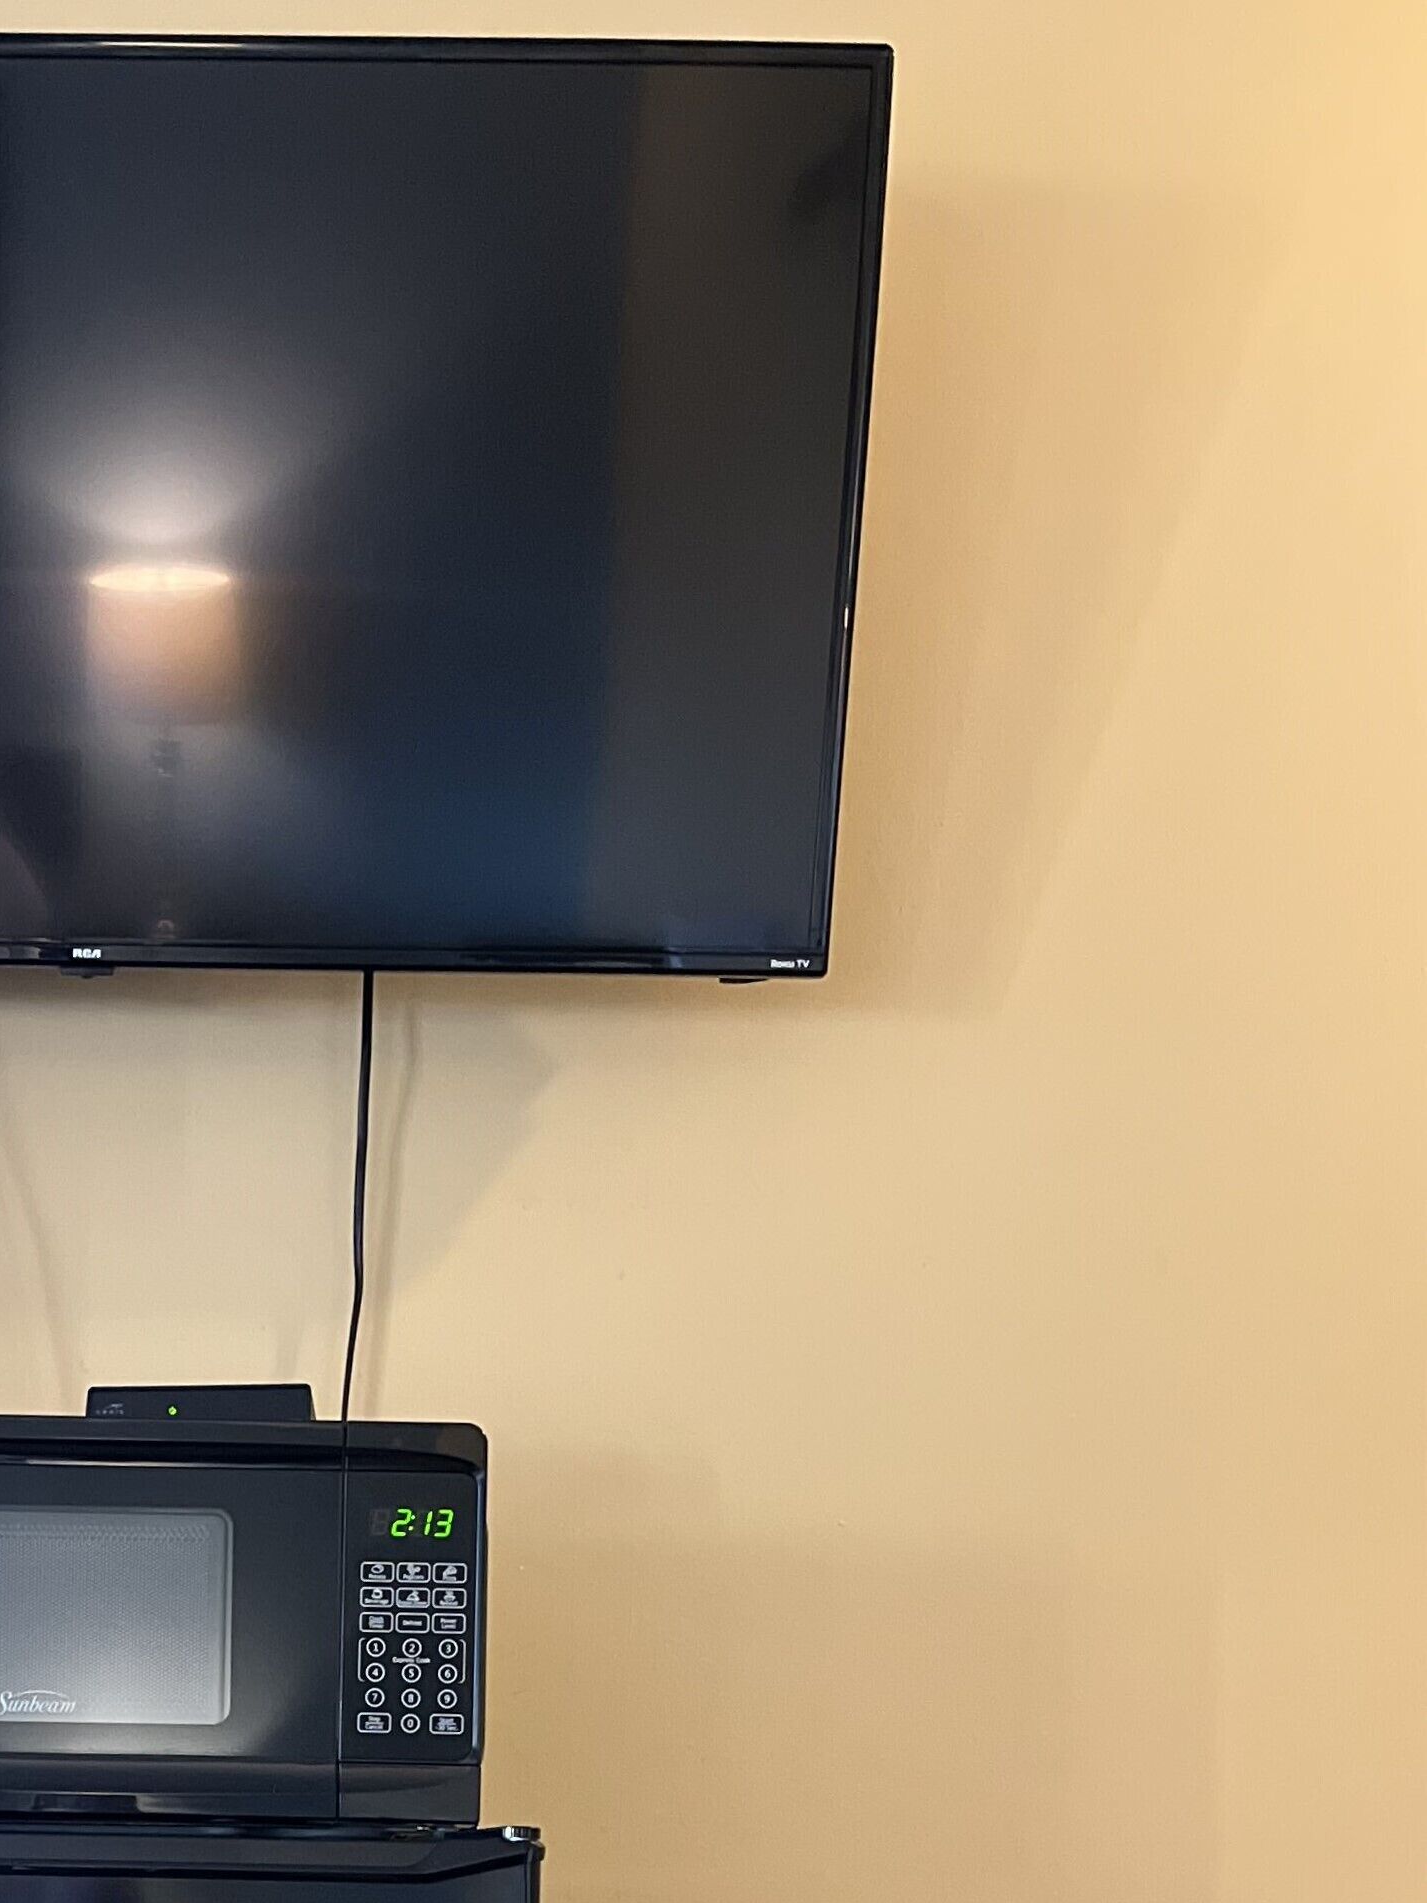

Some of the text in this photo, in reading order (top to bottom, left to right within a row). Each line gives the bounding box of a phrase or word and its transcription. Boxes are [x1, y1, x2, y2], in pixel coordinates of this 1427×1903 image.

[72, 948, 102, 959] RCA
[796, 959, 810, 968] TV
[391, 1508, 454, 1537] 2:13
